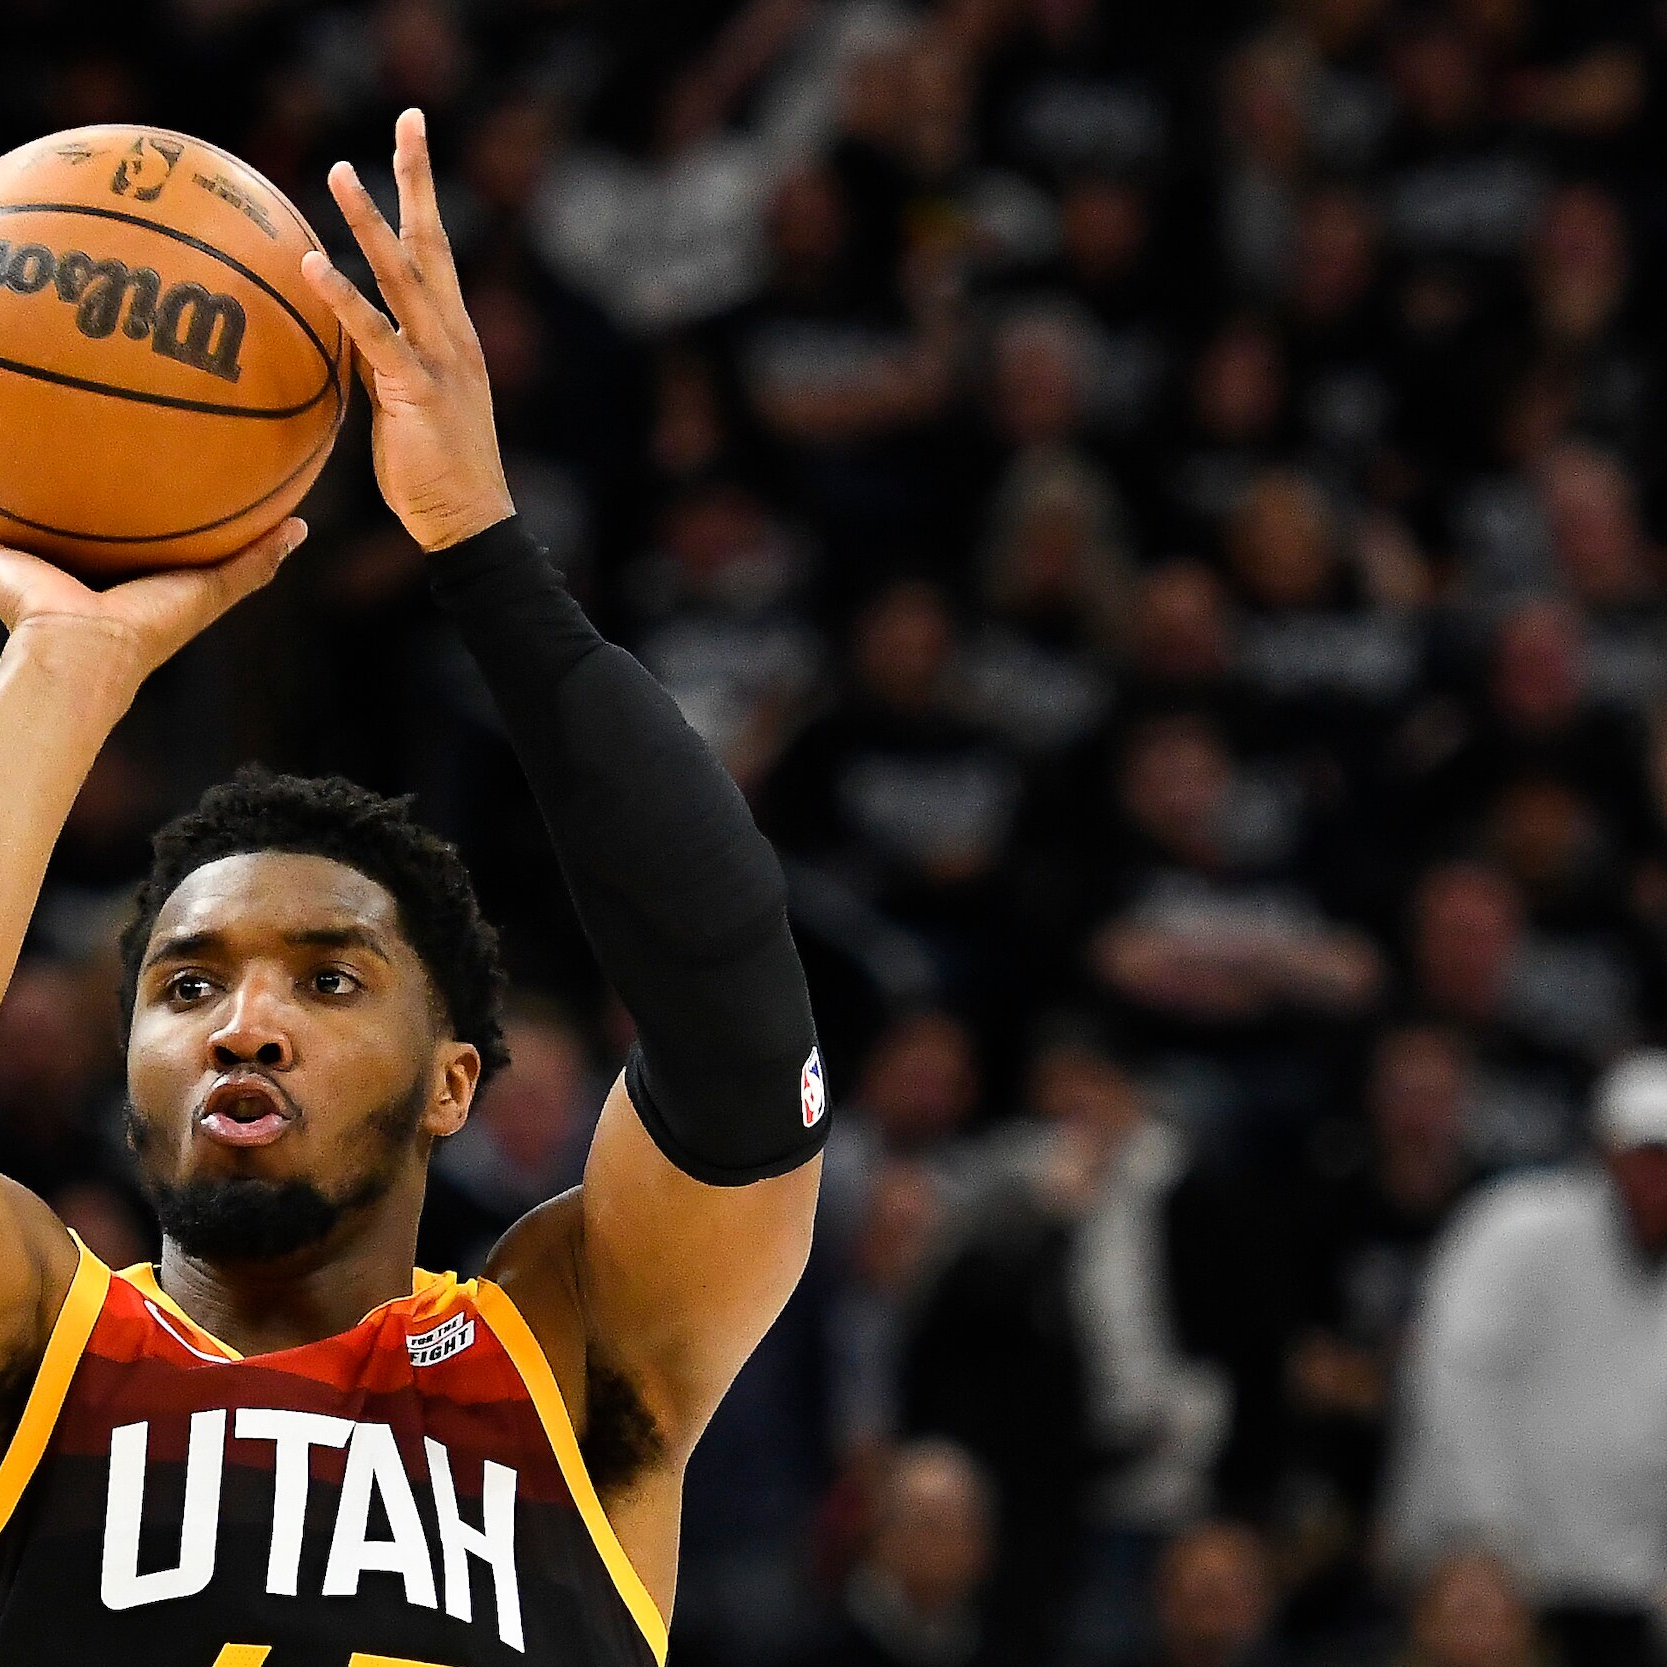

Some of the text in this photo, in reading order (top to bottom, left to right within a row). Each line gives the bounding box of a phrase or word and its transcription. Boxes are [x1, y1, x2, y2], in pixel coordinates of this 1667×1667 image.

[409, 1327, 469, 1363] FIGHT
[411, 1318, 459, 1346] FOR THE
[101, 1407, 525, 1654] UTAH
